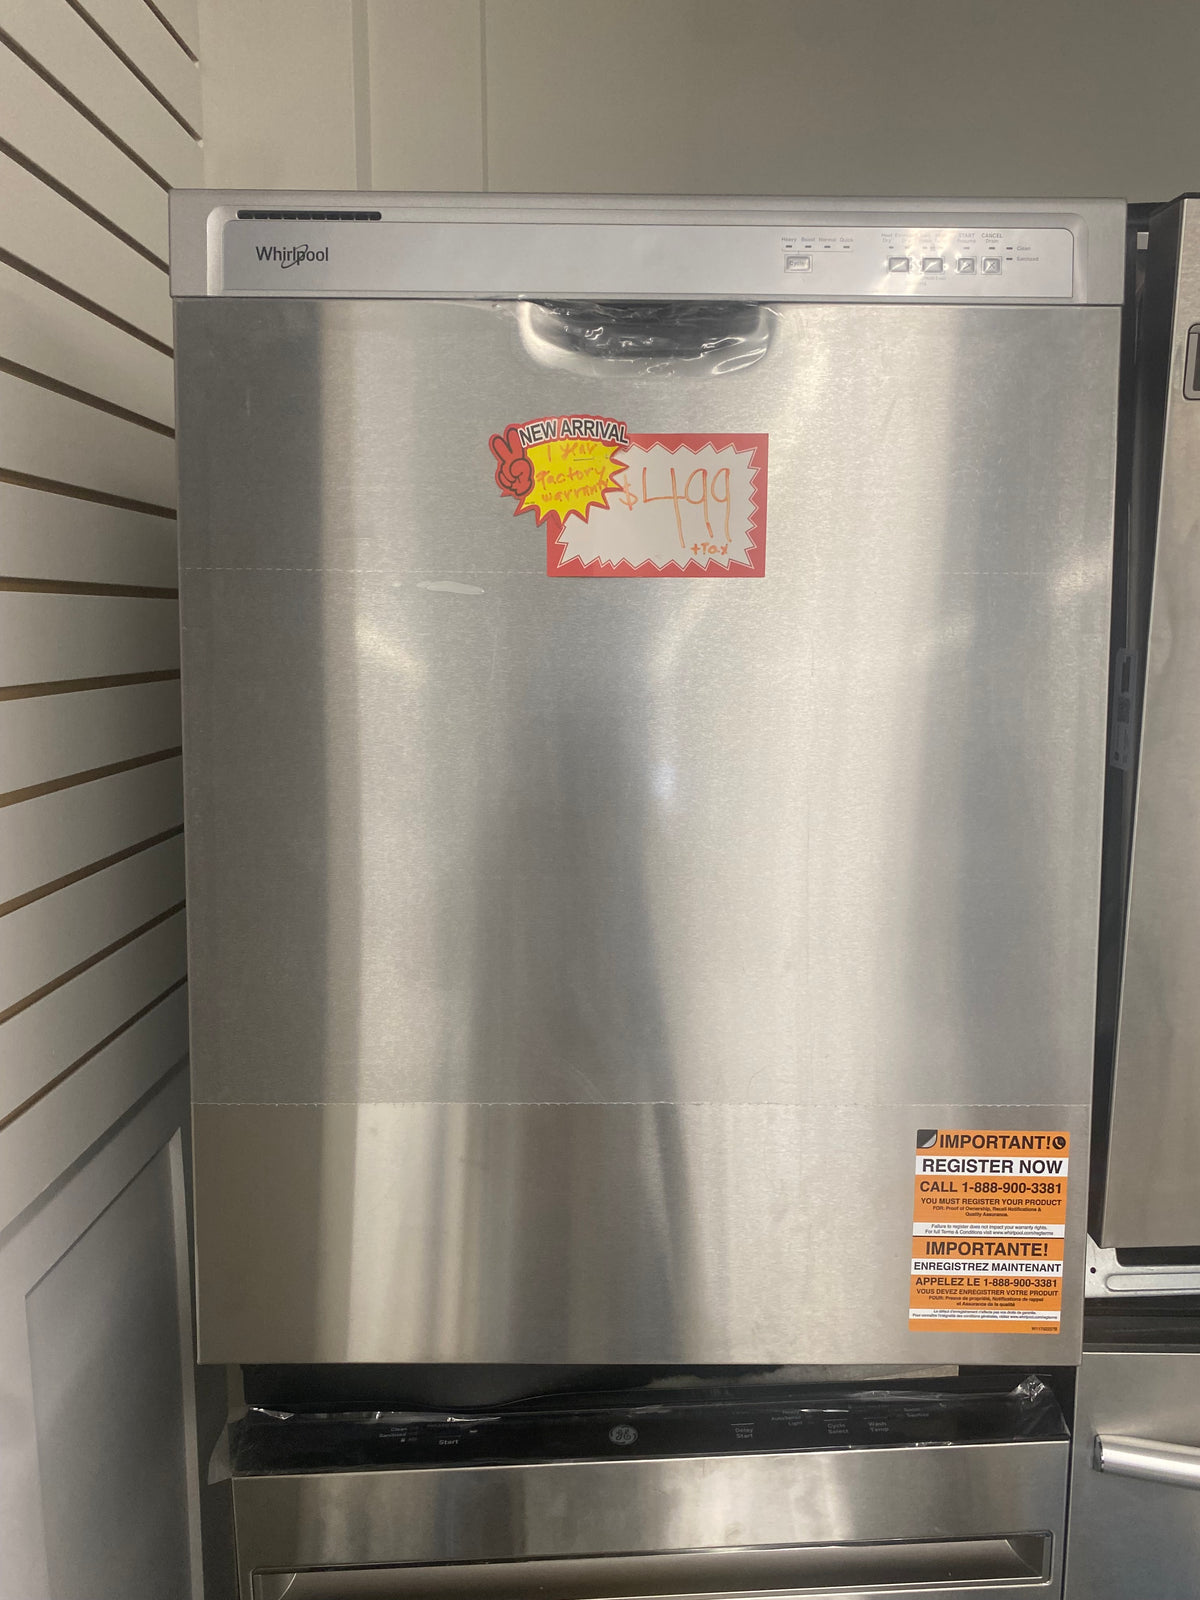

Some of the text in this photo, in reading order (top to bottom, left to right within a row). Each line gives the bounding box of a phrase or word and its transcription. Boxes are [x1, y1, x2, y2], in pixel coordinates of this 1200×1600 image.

[256, 244, 328, 269] Whirlpool
[519, 419, 628, 446] NEW ARRIVAL
[940, 1134, 1051, 1150] IMPORTANT!
[922, 1158, 1063, 1174] REGISTER NOW
[920, 1180, 1062, 1194] CALL 1-888-900-3381
[926, 1242, 1048, 1257] IMPORTANTE!
[914, 1262, 1062, 1273] ENREGISTREZ MAINTENANT
[916, 1277, 1057, 1288] APPELEZ LE 1-888-900-3381
